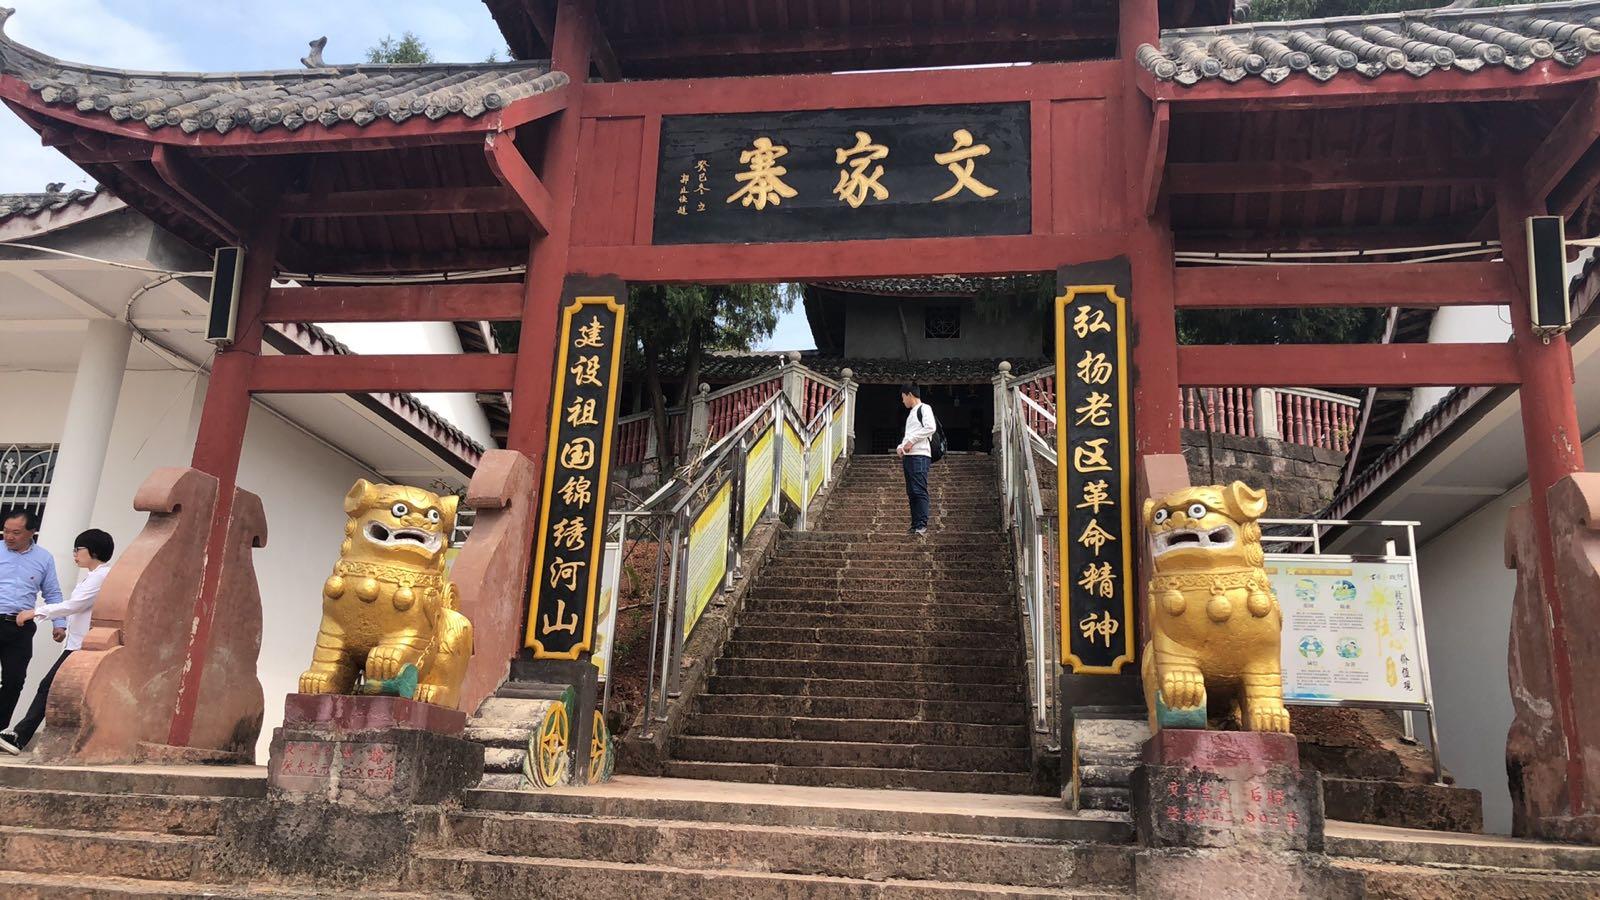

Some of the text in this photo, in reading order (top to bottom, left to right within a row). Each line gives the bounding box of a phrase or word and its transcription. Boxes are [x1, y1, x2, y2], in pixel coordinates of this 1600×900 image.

[726, 129, 998, 210] 文家寨
[542, 315, 605, 636] 建设祖国锦绣河山
[1073, 305, 1119, 648] 弘扬老区革命精神
